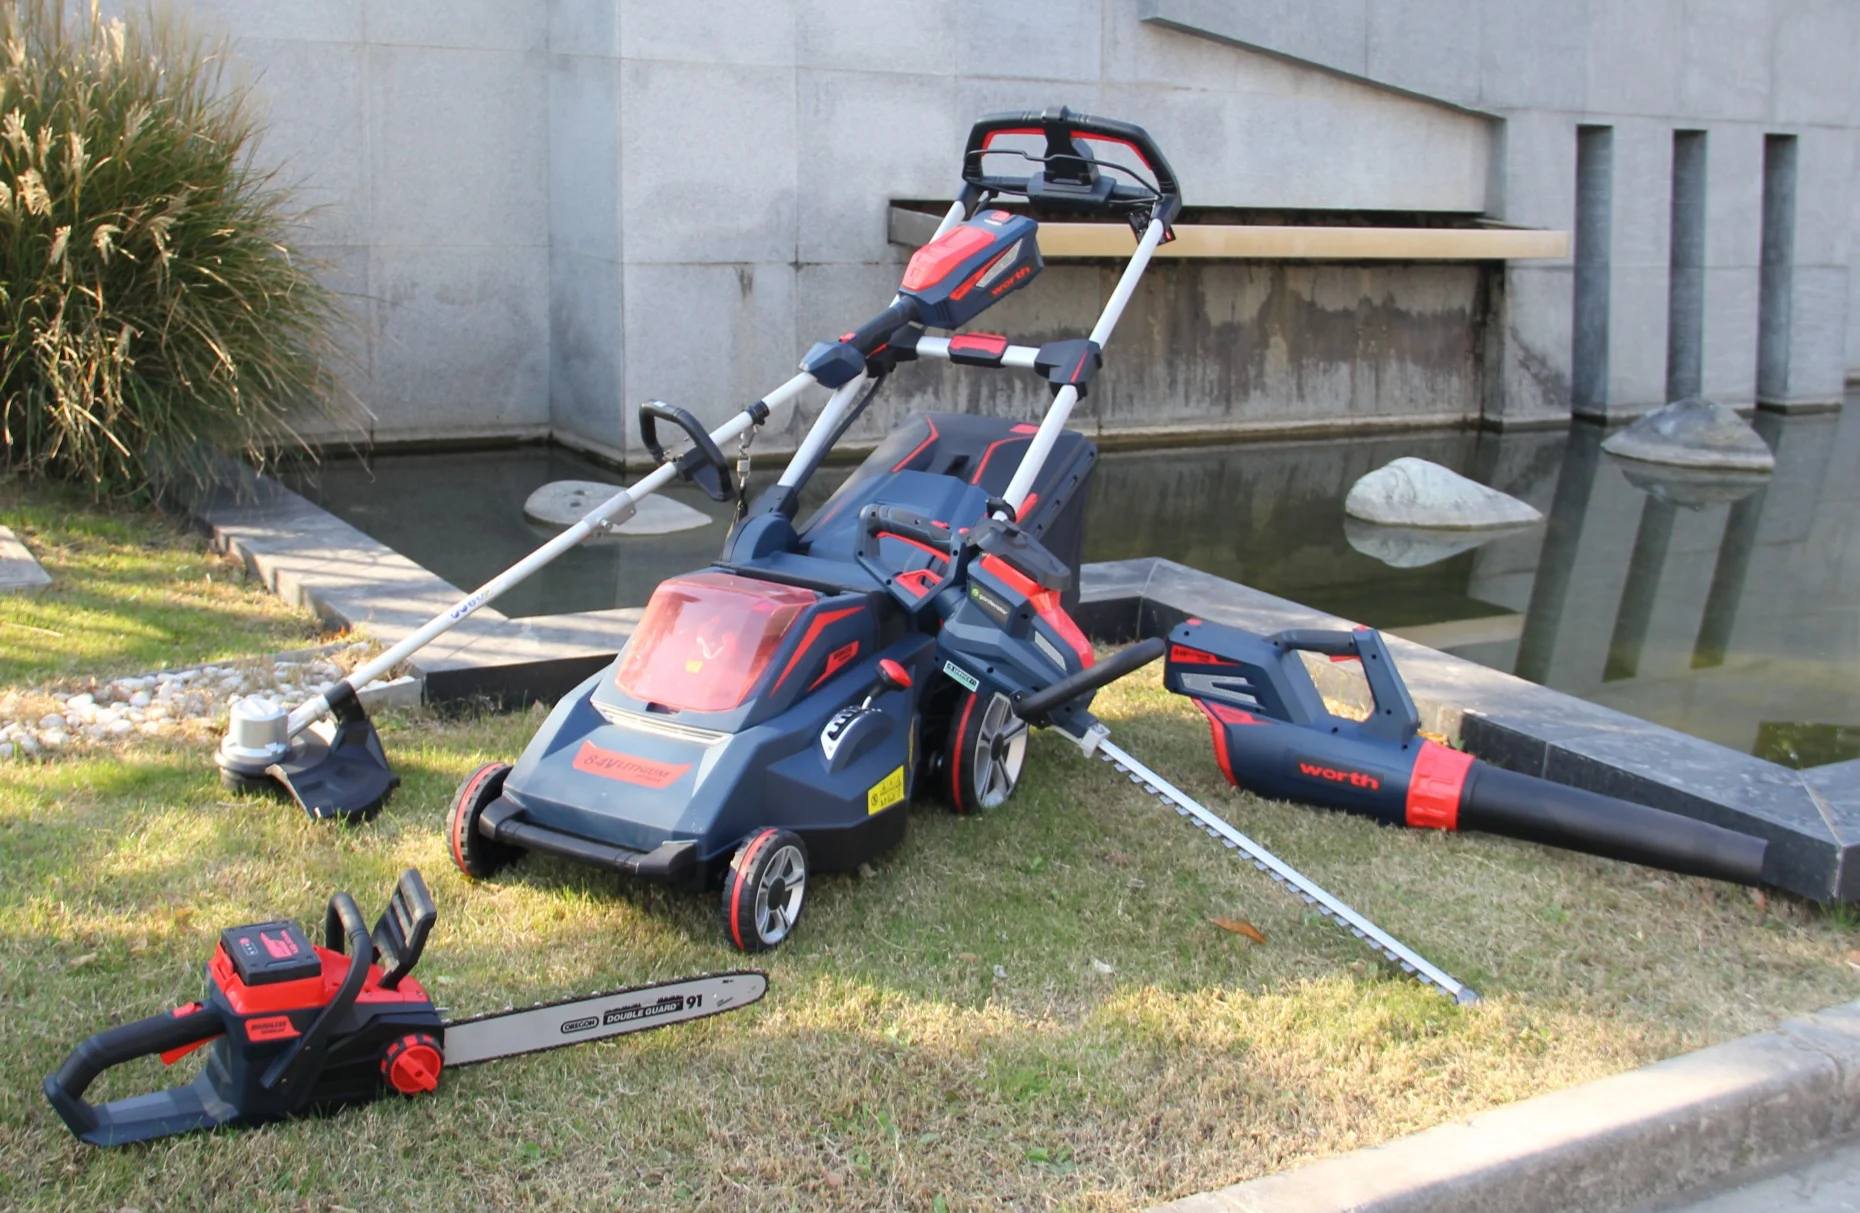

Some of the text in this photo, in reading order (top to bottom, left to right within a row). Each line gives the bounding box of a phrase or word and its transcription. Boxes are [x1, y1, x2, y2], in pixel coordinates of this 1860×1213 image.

[991, 266, 1032, 296] worth
[1299, 762, 1380, 791] worth
[606, 1009, 644, 1024] DOUBLE
[645, 1003, 678, 1017] GUARD
[686, 994, 703, 1009] 91
[563, 1018, 596, 1031] OREGON
